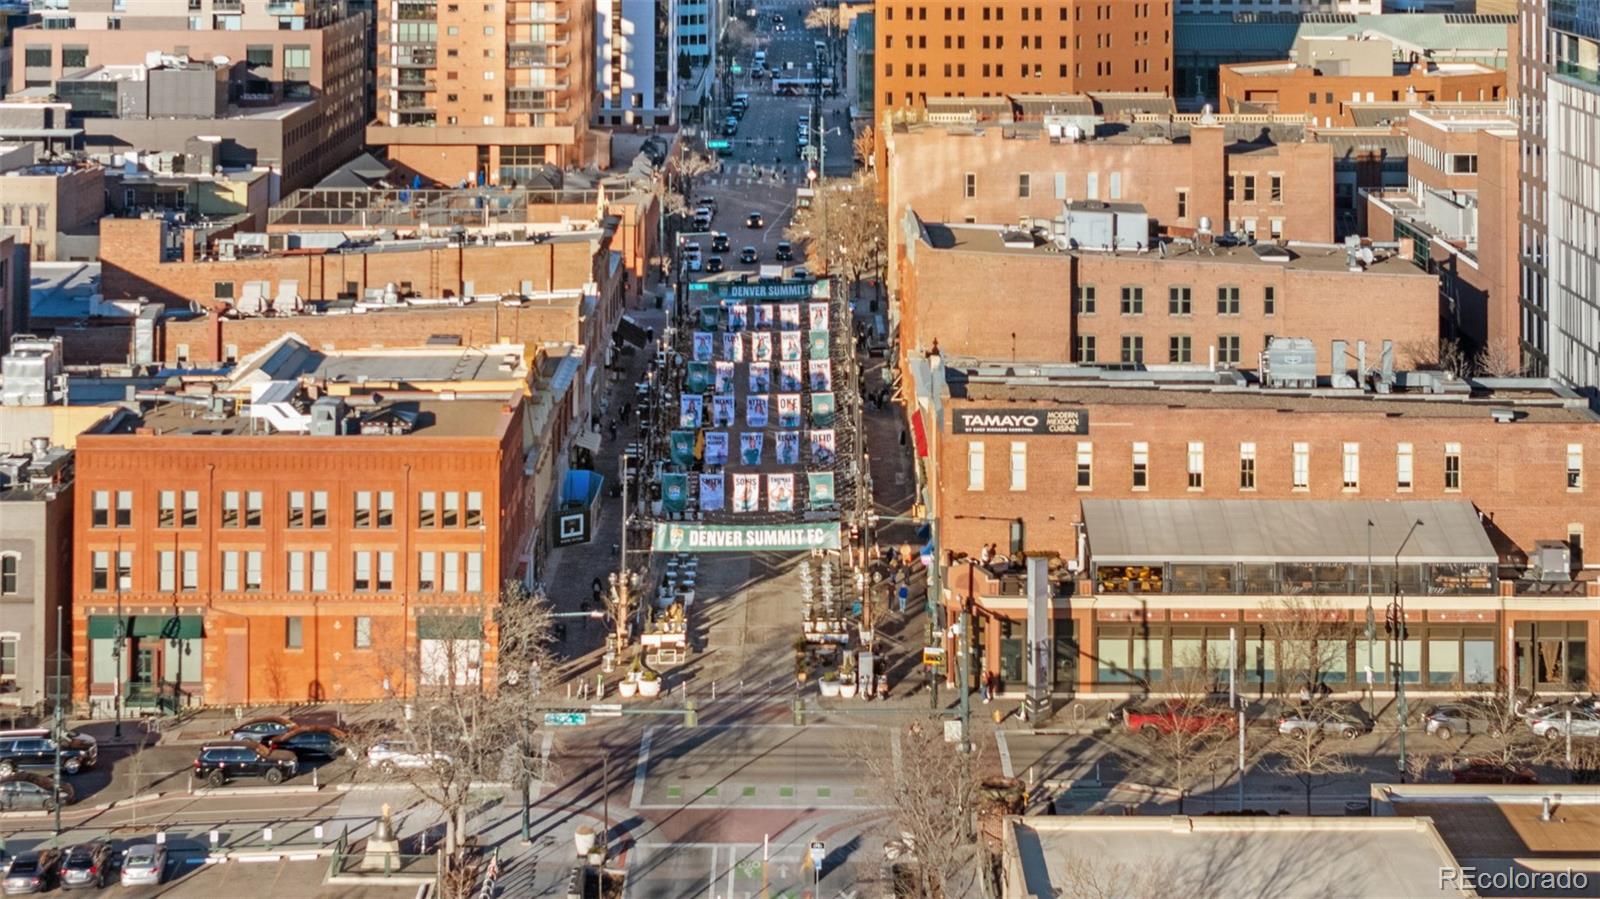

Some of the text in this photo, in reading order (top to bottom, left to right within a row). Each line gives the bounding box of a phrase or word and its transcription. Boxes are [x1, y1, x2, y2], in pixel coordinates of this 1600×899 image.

[731, 286, 767, 297] DENVER
[768, 285, 806, 296] SUMMIT
[962, 415, 1039, 427] TAMAYO
[1046, 418, 1080, 426] MEXICAN
[1049, 425, 1077, 433] CUISINE
[689, 528, 824, 547] DENVER SUMMIT FC
